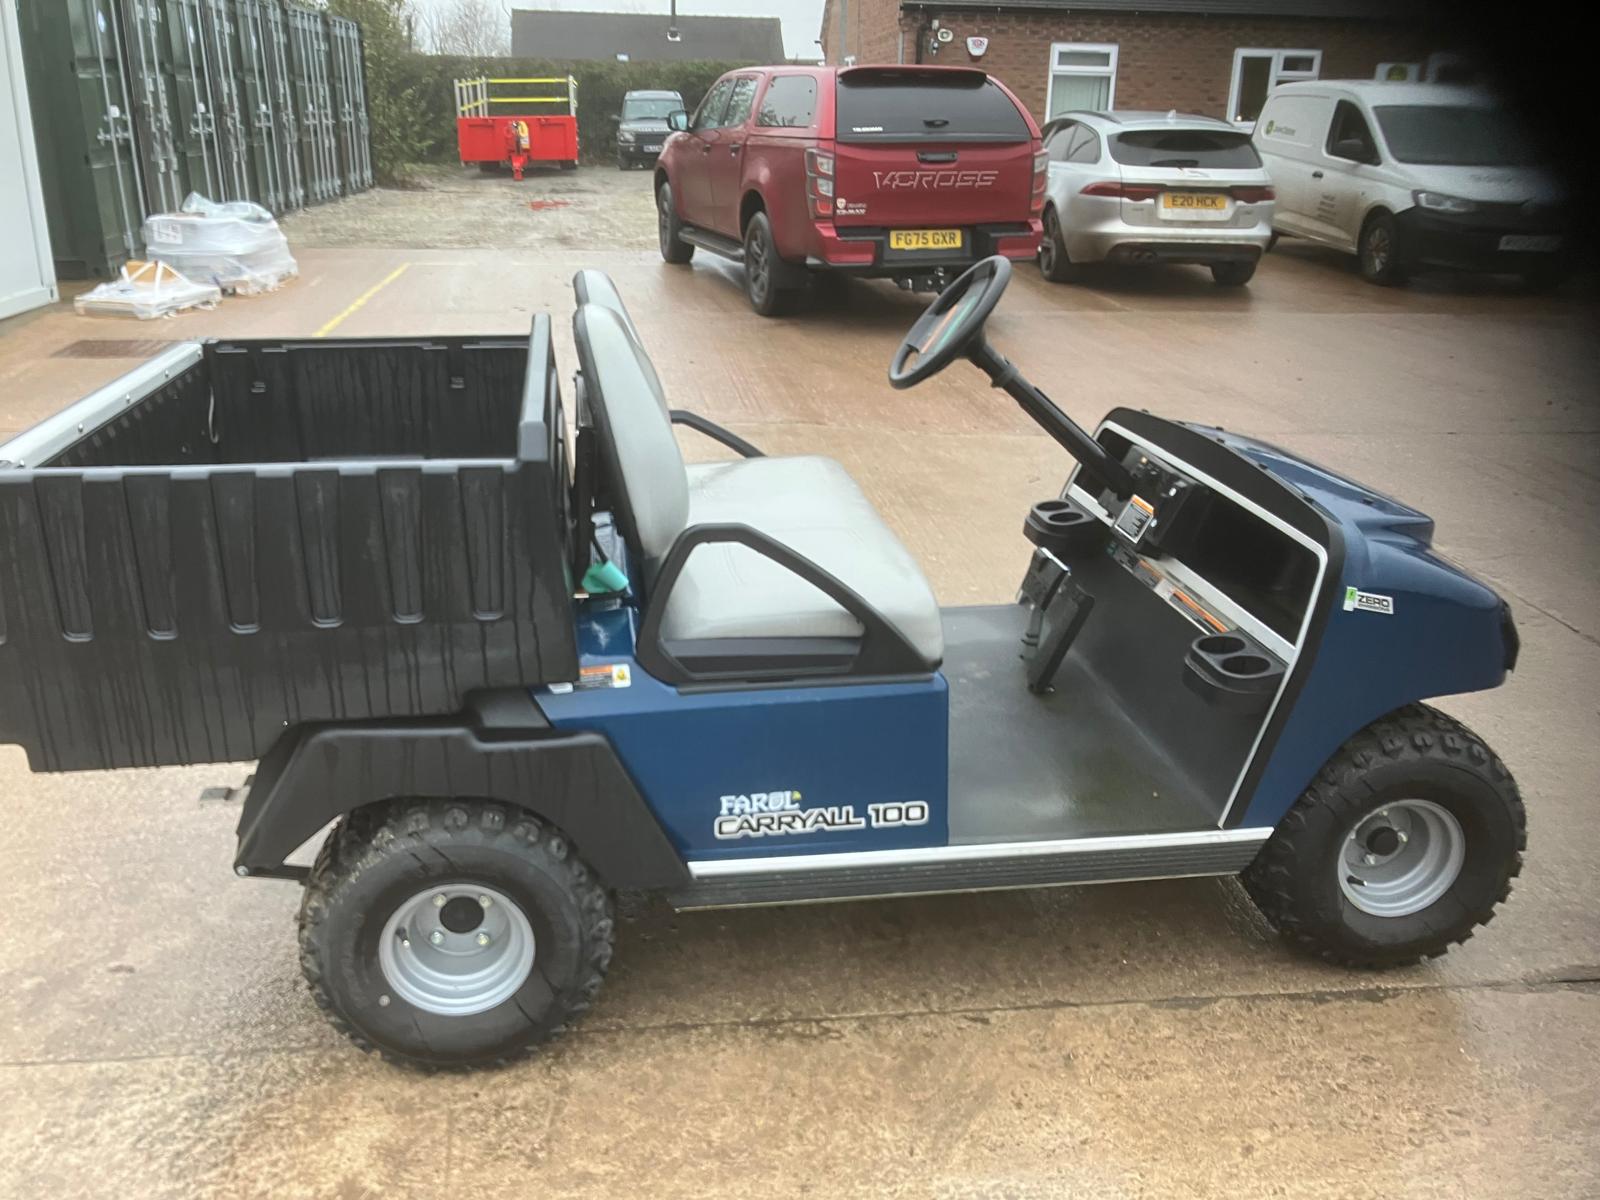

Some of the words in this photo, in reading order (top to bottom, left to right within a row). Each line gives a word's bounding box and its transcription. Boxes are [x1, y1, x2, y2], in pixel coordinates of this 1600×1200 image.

[1171, 195, 1194, 207] E20
[1196, 195, 1218, 207] HCK
[895, 231, 929, 246] FG75
[931, 231, 957, 246] GXR
[1358, 595, 1390, 608] ZERO
[719, 790, 800, 816] FAROL
[716, 806, 865, 838] CARRYALL
[869, 802, 928, 827] 100
